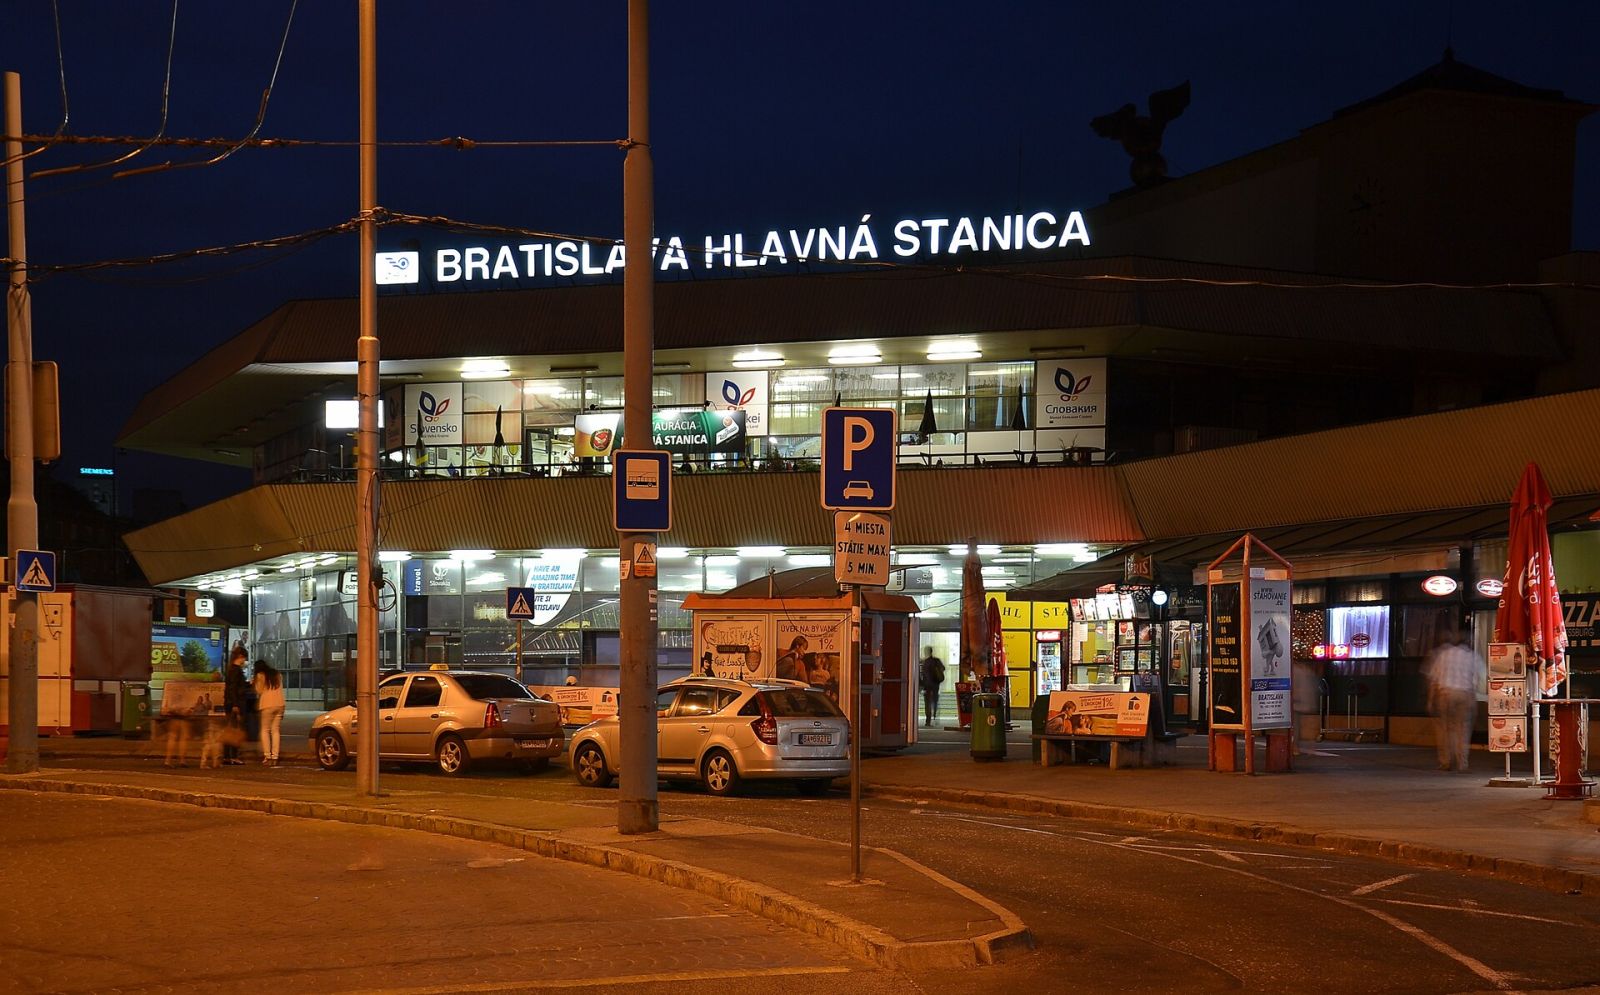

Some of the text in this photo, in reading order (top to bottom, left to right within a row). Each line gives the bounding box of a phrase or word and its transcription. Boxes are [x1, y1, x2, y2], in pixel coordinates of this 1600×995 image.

[436, 209, 1092, 283] BRATISLAA HLAVNÁ STANICA
[1045, 403, 1097, 414] Словакия
[410, 422, 458, 435] Sovensko
[652, 419, 697, 432] AURÁCIA
[664, 434, 708, 446] STANICA
[843, 416, 875, 471] P
[844, 521, 885, 536] 4 MIESTA
[838, 539, 888, 557] STÁTIE MAX.
[847, 561, 877, 575] 5 MIN.
[531, 573, 576, 581] AMAZING TIME
[1564, 601, 1600, 627] ZZA
[818, 637, 833, 650] 1%
